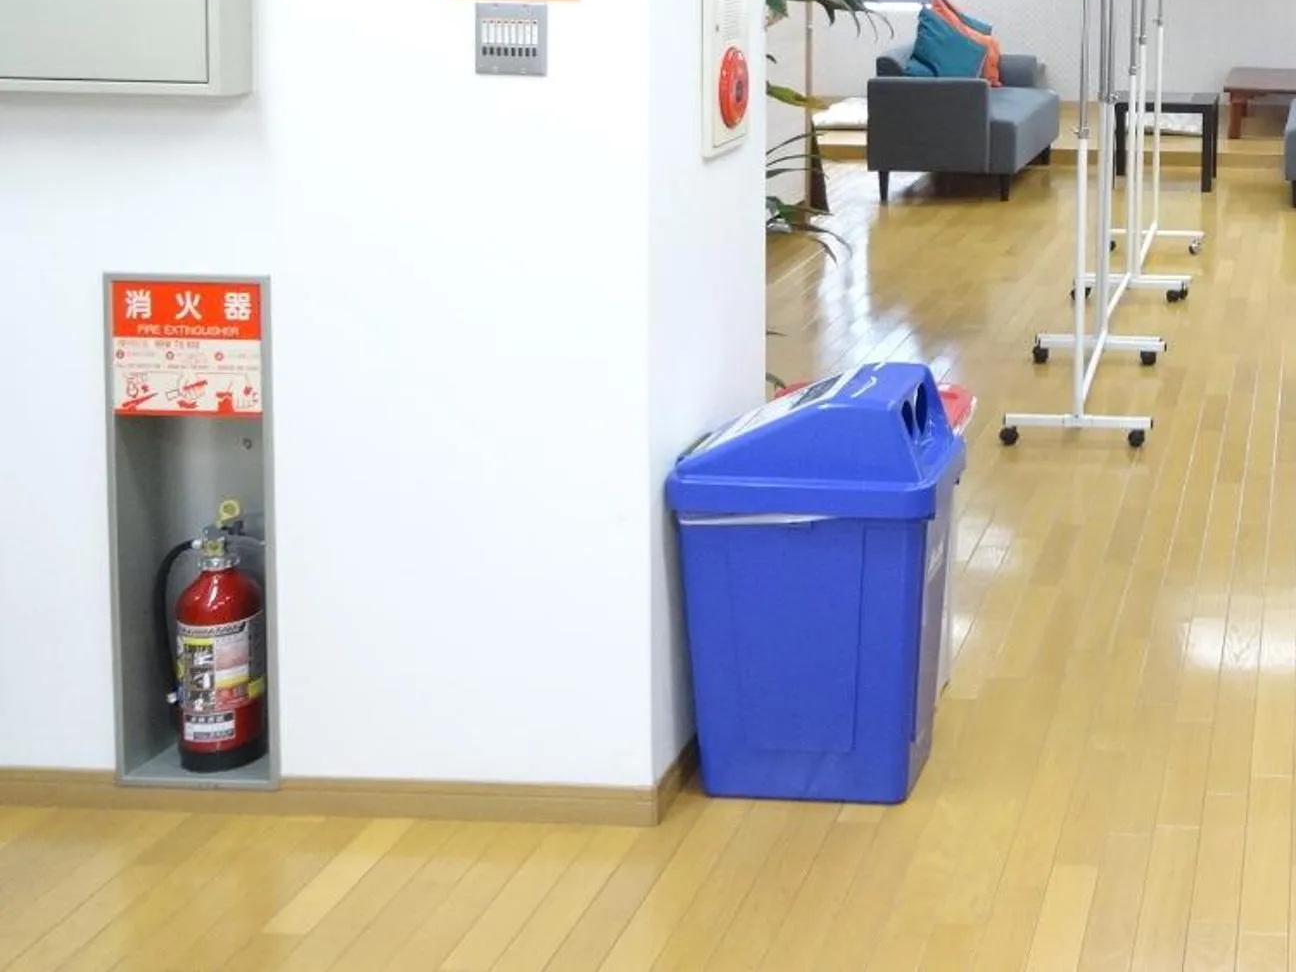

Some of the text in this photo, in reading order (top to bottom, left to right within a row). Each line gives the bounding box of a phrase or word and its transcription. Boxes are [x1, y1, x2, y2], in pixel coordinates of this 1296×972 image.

[125, 289, 252, 321] 消火器
[137, 324, 240, 337] FIRE EXTINGUISHER
